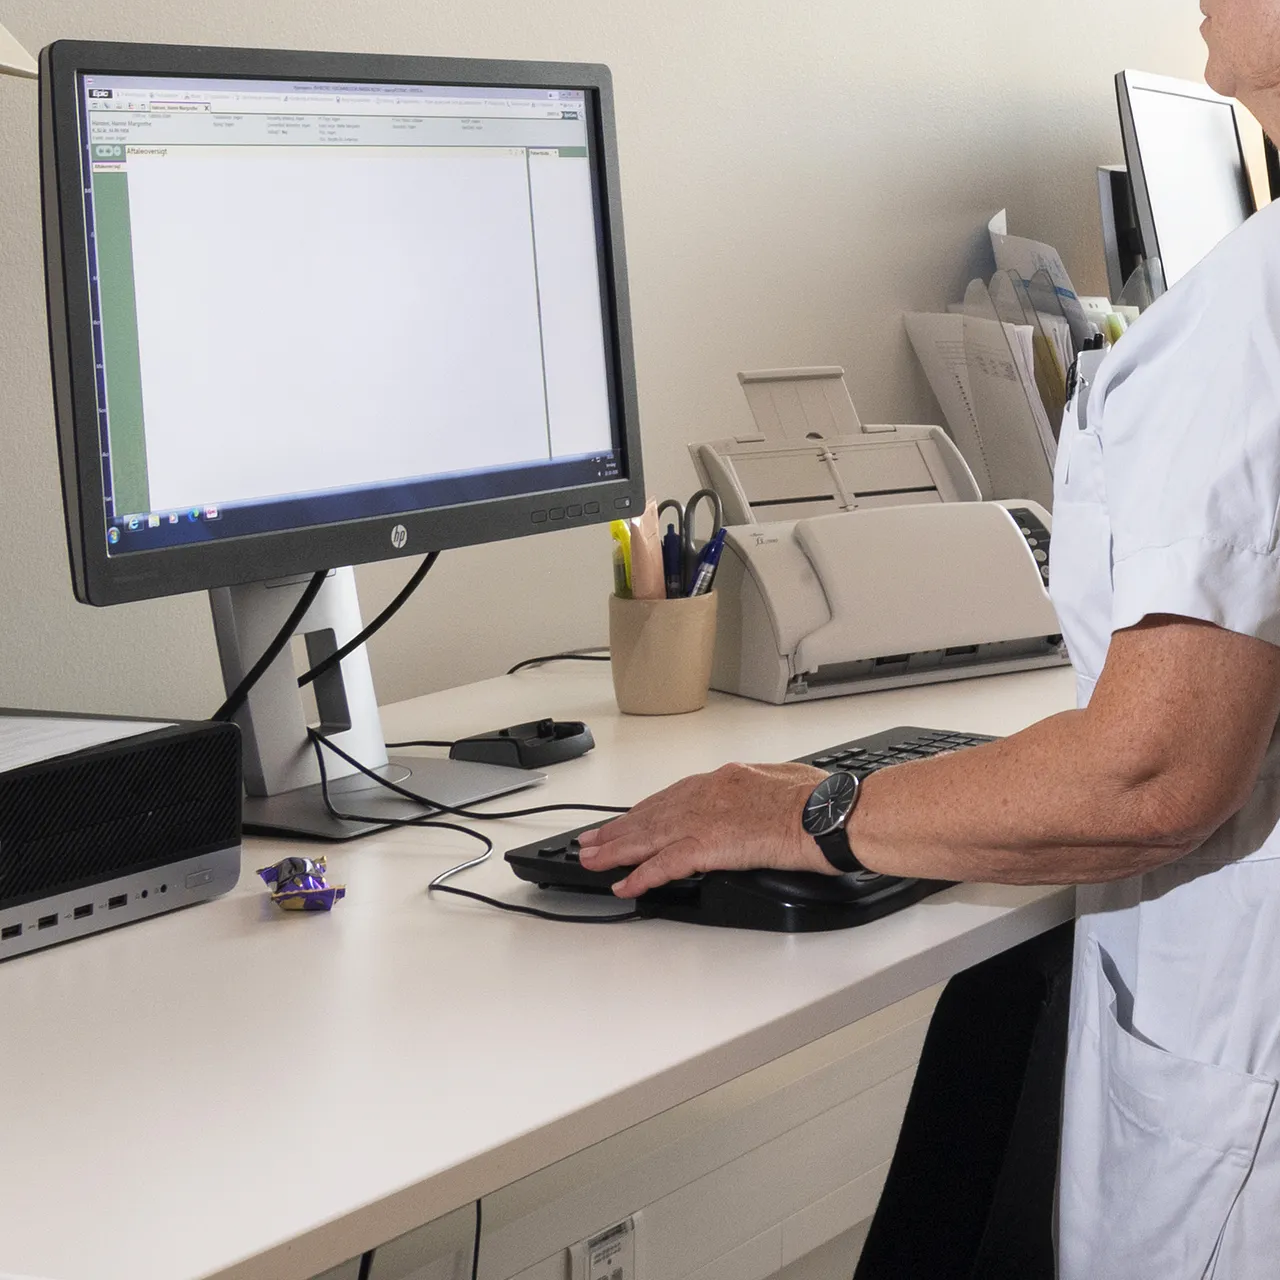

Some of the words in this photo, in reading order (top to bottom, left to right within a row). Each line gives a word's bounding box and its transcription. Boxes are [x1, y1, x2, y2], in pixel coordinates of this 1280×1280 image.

[92, 89, 109, 98] Epic
[127, 148, 168, 157] Aftaleoversigt
[394, 525, 406, 548] hp
